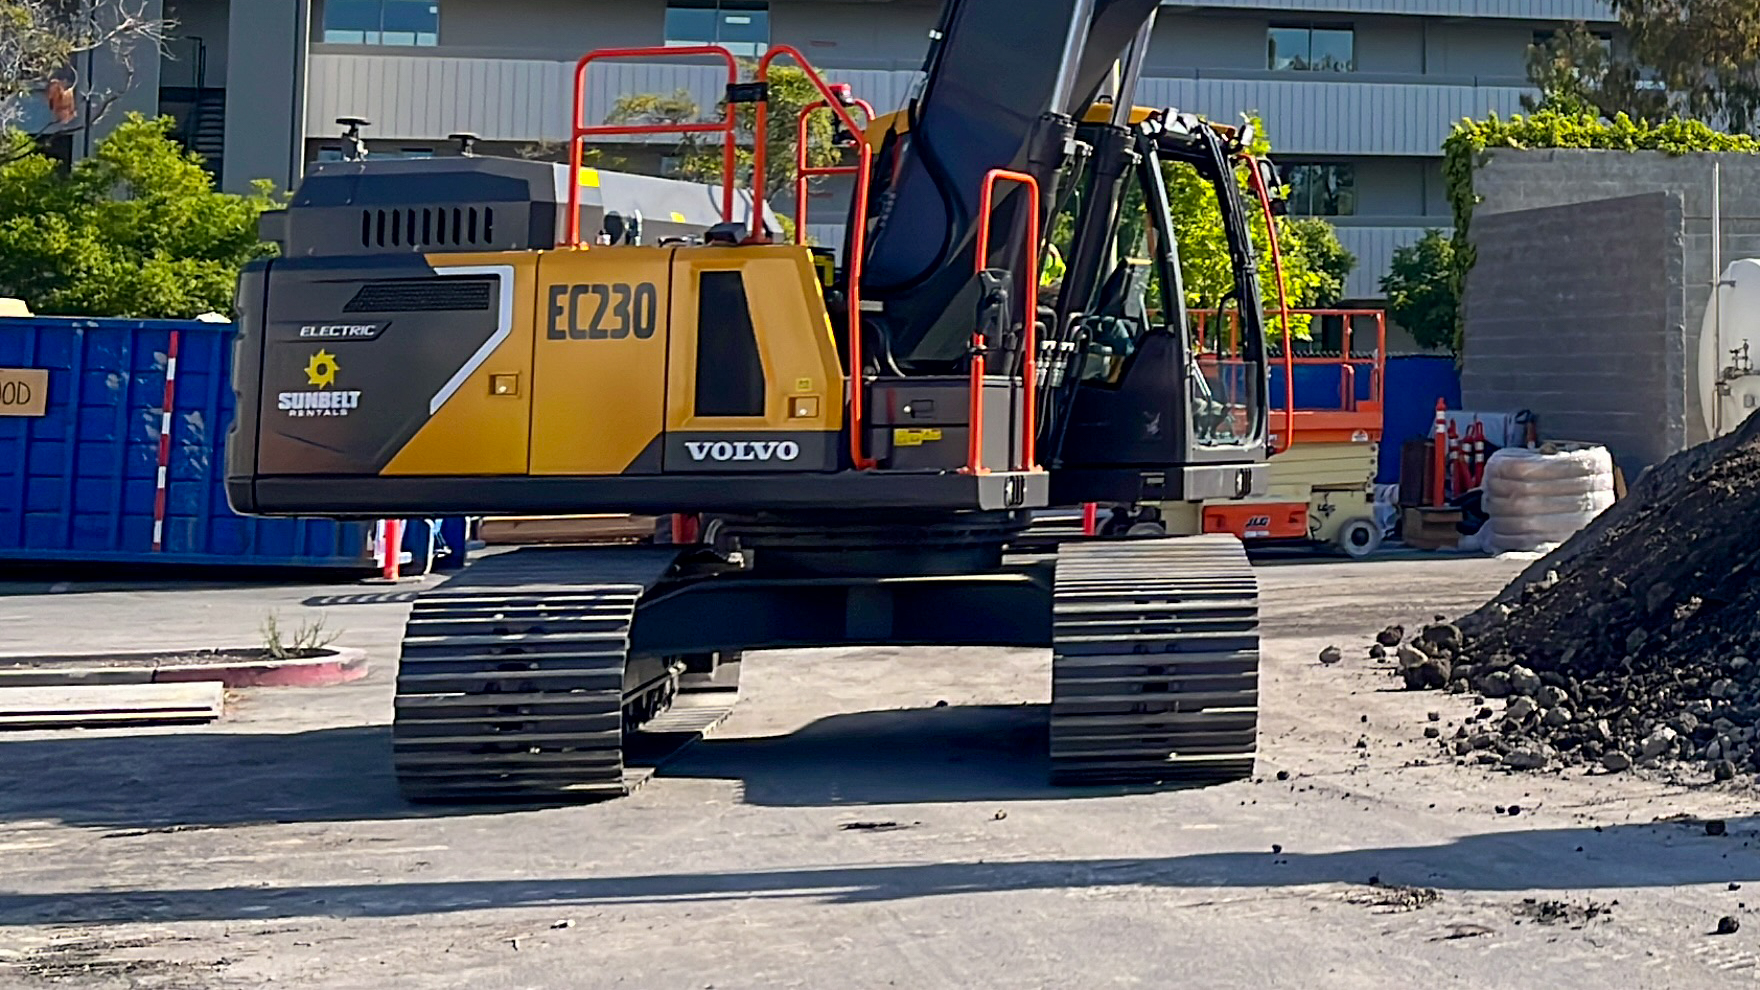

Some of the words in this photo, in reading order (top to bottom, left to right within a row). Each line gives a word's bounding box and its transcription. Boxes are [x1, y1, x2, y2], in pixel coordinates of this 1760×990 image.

[547, 282, 656, 340] EC230
[300, 324, 377, 337] ELECTRIC
[0, 381, 31, 405] OD
[278, 391, 361, 410] SUNBELT
[288, 409, 348, 417] RENTALS
[684, 441, 799, 460] VOLVO
[1245, 515, 1270, 528] JLG
